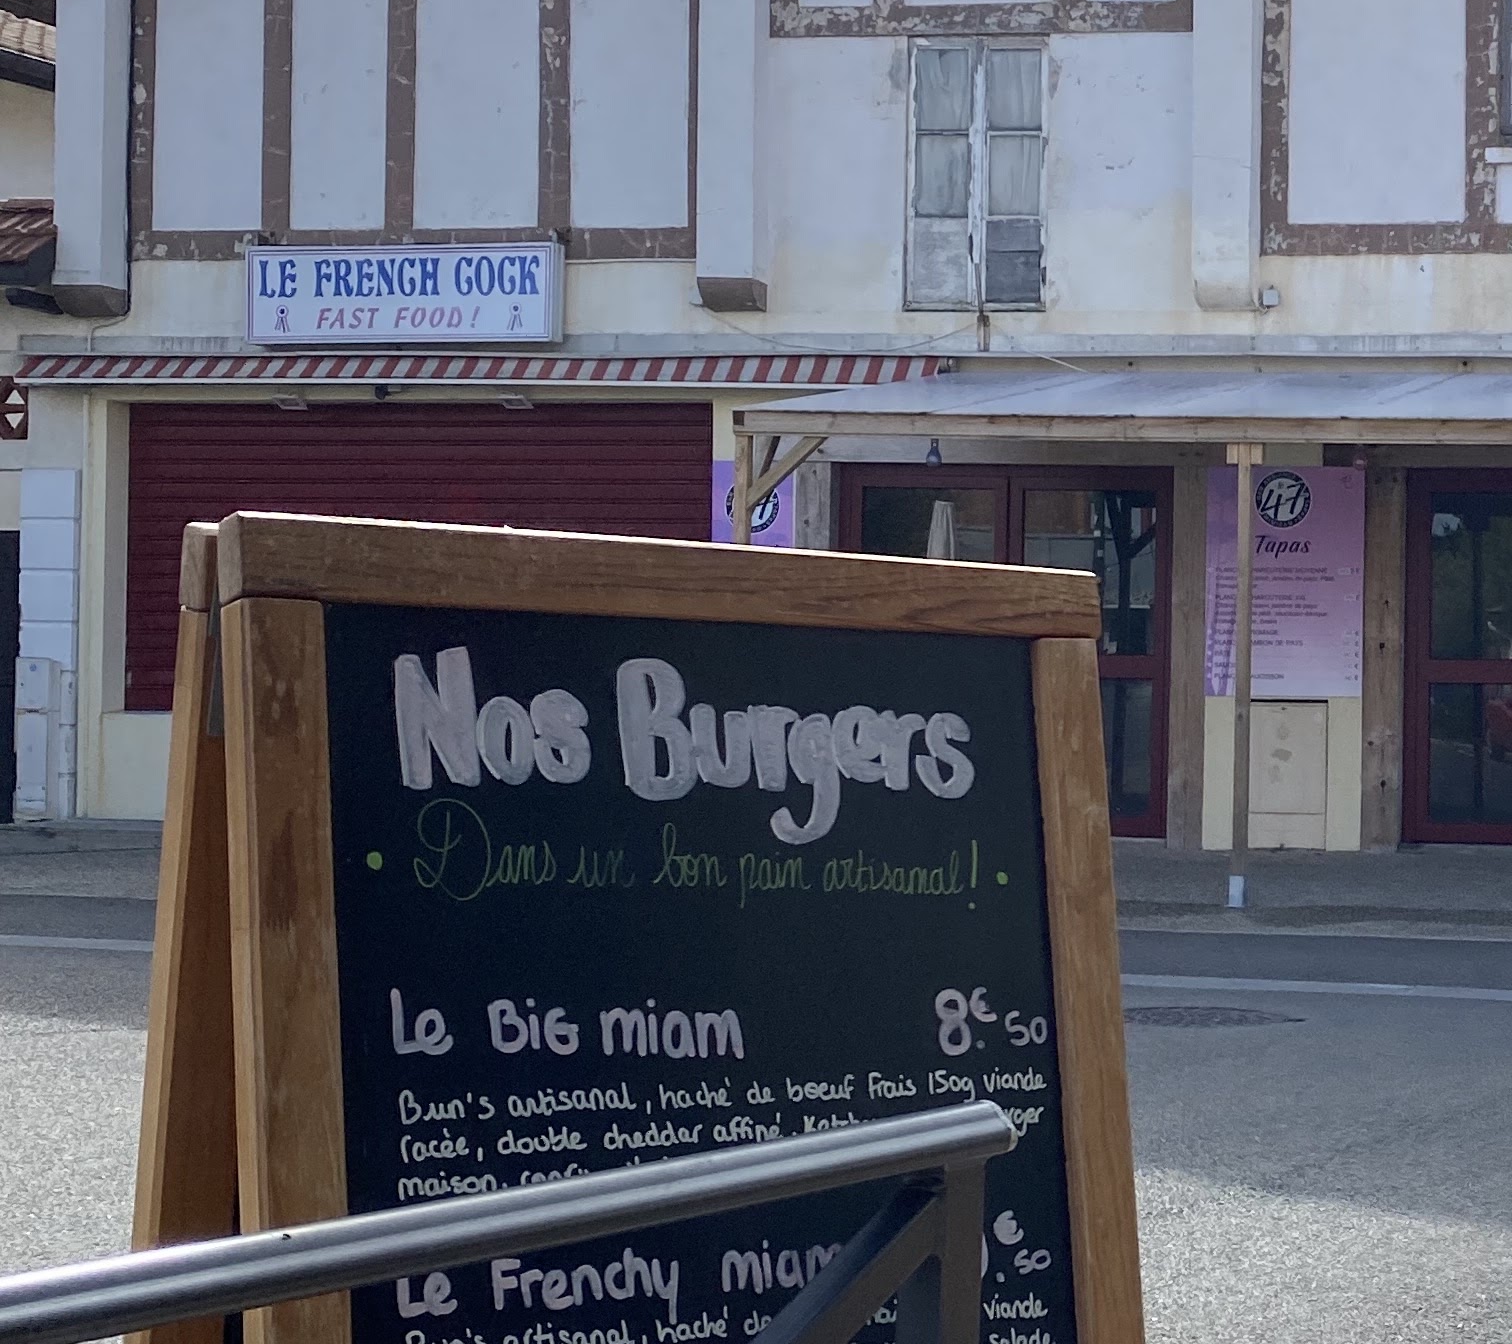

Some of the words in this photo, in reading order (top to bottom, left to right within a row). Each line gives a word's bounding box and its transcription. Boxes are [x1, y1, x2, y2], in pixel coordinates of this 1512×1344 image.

[258, 259, 298, 299] LE
[313, 256, 441, 298] FRENCH
[453, 255, 541, 297] COCK
[316, 307, 380, 330] FAST
[1254, 534, 1312, 559] Tapas
[393, 645, 593, 790] Nos
[616, 657, 977, 845] Burgers
[413, 797, 557, 901] Dans
[653, 822, 731, 888] bon
[738, 849, 811, 909] pain
[389, 987, 454, 1055] Le
[600, 999, 746, 1059] miam
[398, 1089, 496, 1126] Bun's
[658, 1076, 733, 1111] haché
[746, 1079, 777, 1105] de
[981, 1066, 1048, 1094] viande
[496, 1125, 589, 1156] double
[603, 1120, 703, 1150] cheddar
[395, 1270, 458, 1319] Le
[490, 1246, 680, 1325] Frenchy
[656, 1304, 729, 1344] haché
[982, 1291, 1049, 1321] viande
